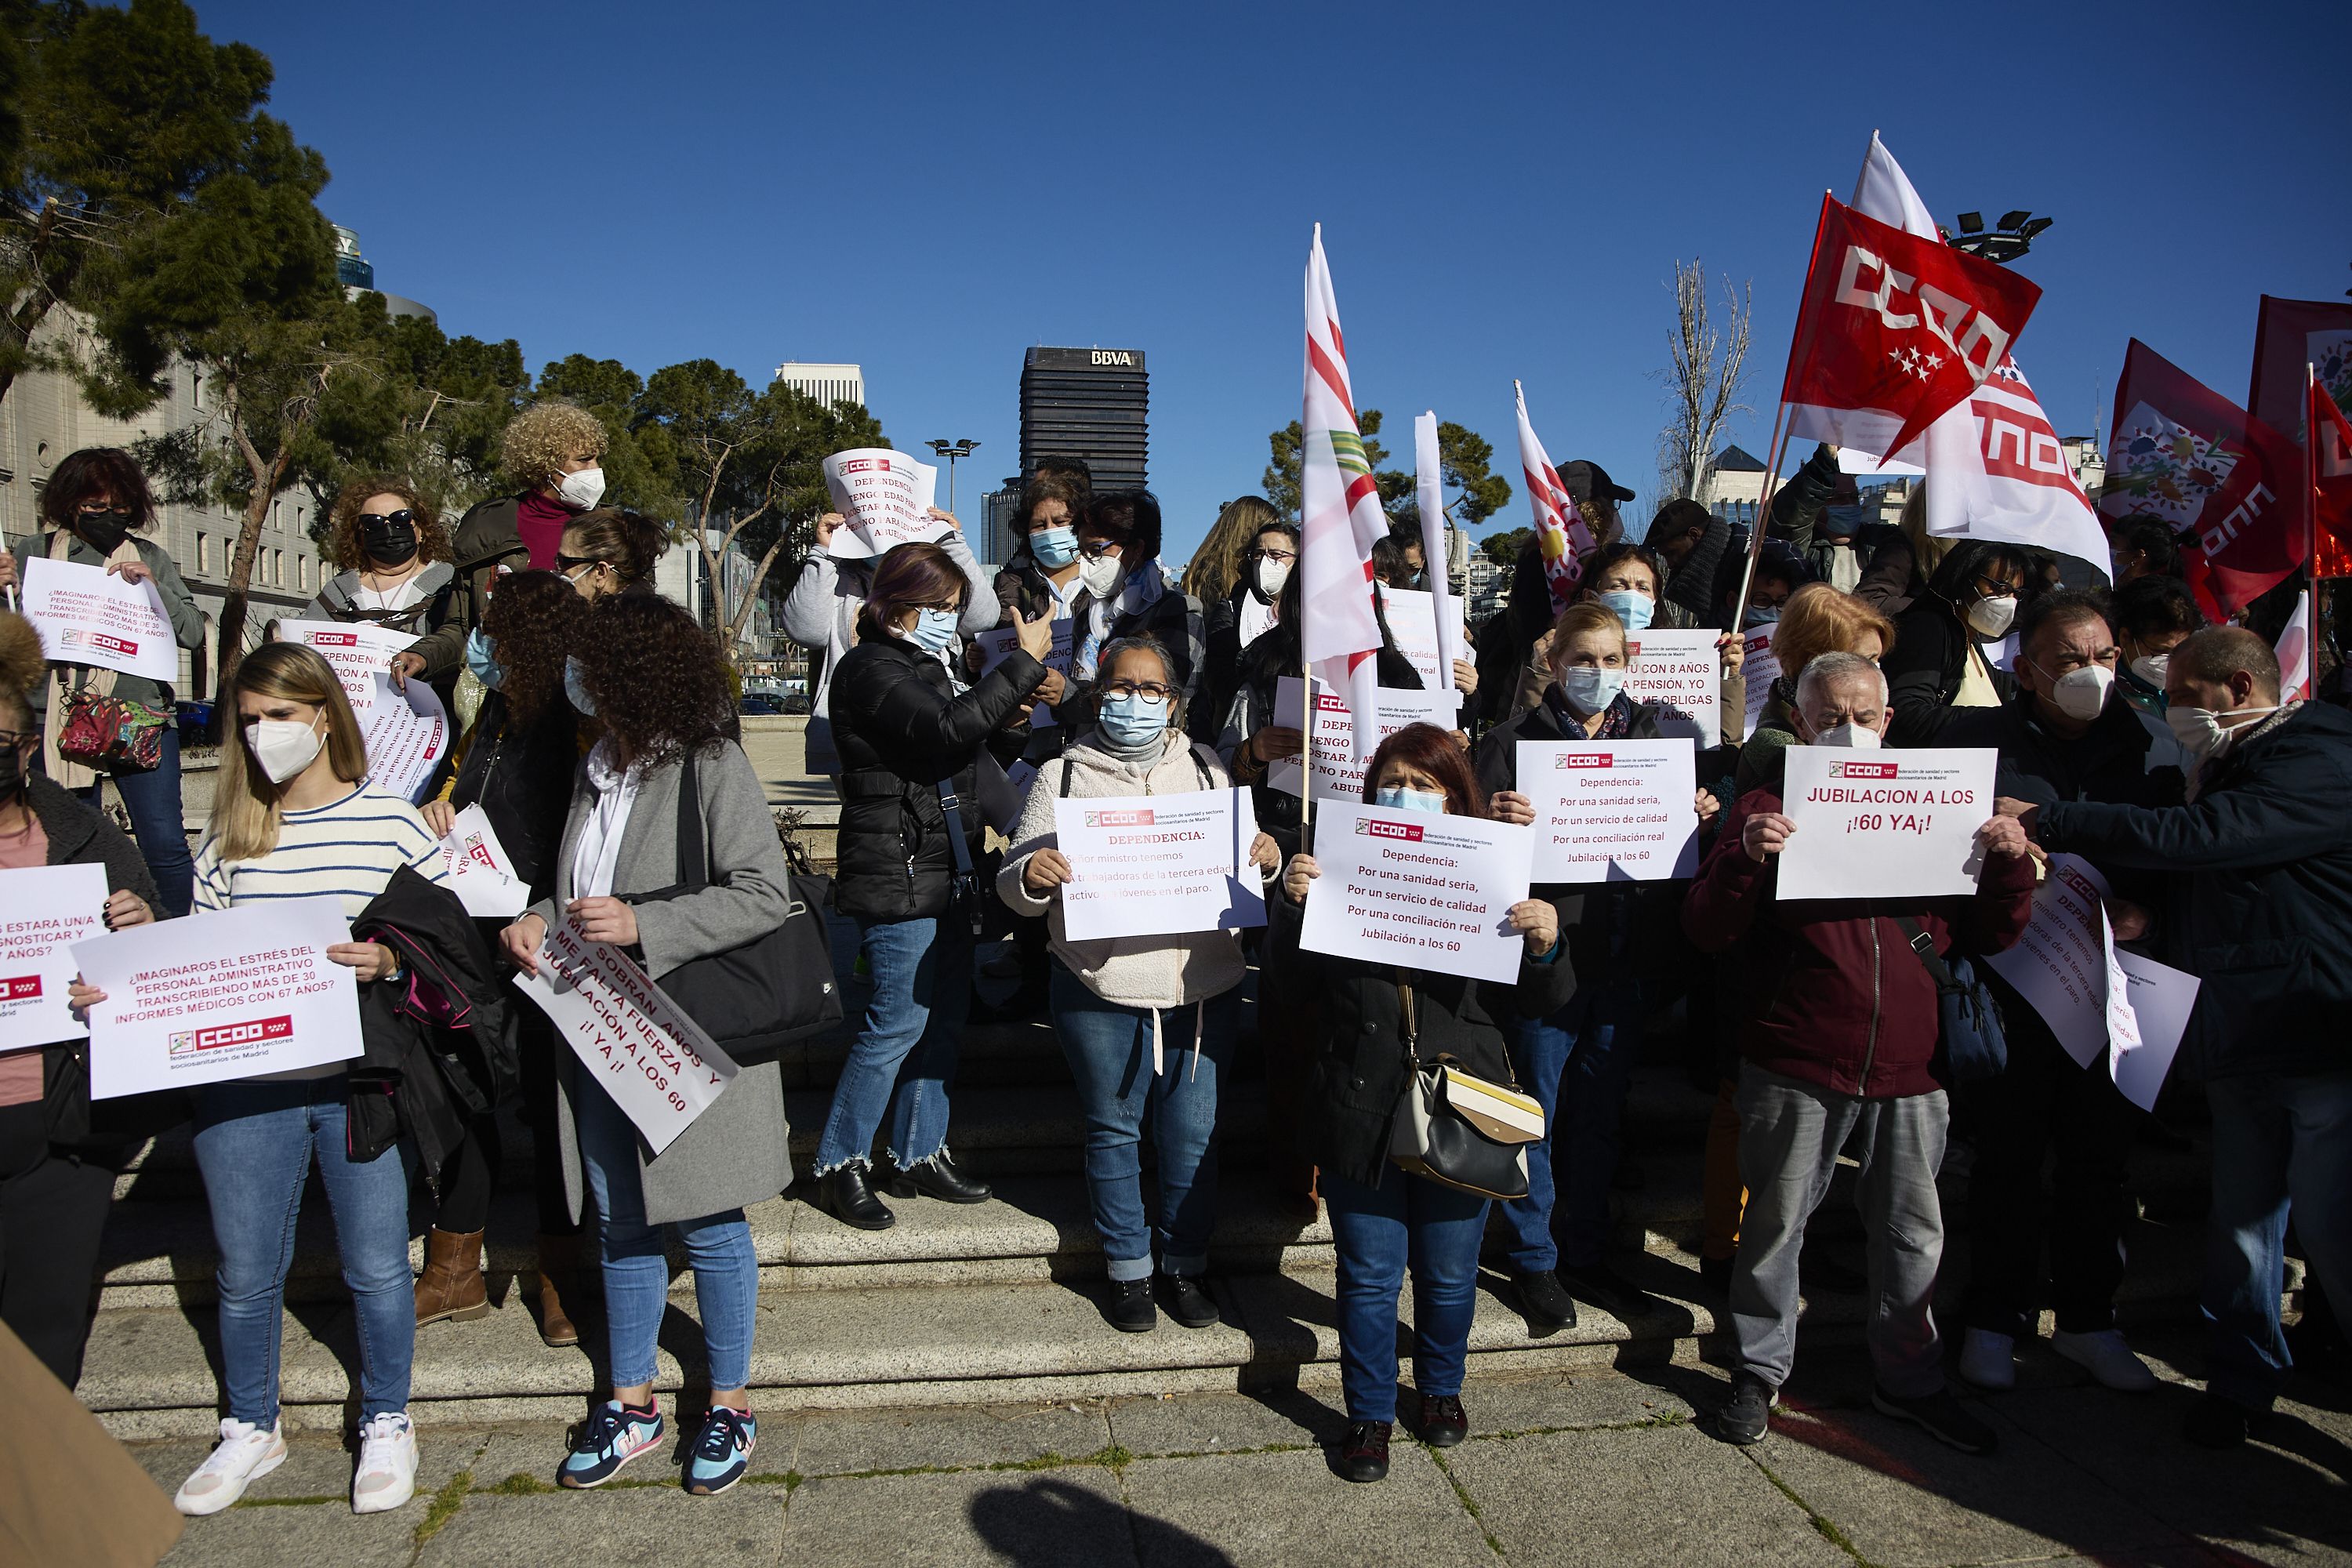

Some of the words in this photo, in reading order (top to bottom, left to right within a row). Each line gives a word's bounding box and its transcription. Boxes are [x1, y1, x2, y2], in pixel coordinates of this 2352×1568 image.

[1835, 245, 2010, 386] CCOO
[1092, 351, 1131, 365] BBVA
[850, 461, 878, 470] CCOO
[849, 491, 880, 503] TENGO
[884, 492, 904, 502] EDAD
[906, 498, 916, 510] PARA
[862, 517, 875, 526] NO
[119, 601, 151, 612] ESTRÉS
[34, 611, 75, 619] INFORMES
[117, 623, 132, 632] CON
[1624, 662, 1638, 673] TÚ
[1642, 665, 1666, 673] CON
[1679, 662, 1709, 673] AÑOS
[1633, 678, 1685, 690] PENSIÓN,
[1689, 680, 1704, 688] YO
[1642, 696, 1660, 705] ME
[1662, 695, 1712, 705] OBLIGAS
[1663, 710, 1694, 720] AÑOS
[430, 720, 442, 747] CCOO
[1310, 735, 1349, 747] TENGO
[397, 731, 427, 782] Dependencia:
[1570, 757, 1599, 765] CCOO
[1319, 766, 1335, 775] NO
[1846, 765, 1882, 776] CCOO
[1581, 779, 1642, 788] Dependencia:
[1560, 797, 1576, 806] Por
[1599, 796, 1634, 805] sanidad
[1637, 796, 1661, 804] seria,
[1807, 788, 1917, 804] JUBILACION
[1923, 790, 1934, 803] A
[1941, 790, 1973, 804] LOS
[1102, 814, 1135, 823] CCOO
[1623, 815, 1633, 823] de
[1636, 814, 1668, 822] calidad
[1109, 831, 1205, 844] DEPENDENCIA:
[1372, 824, 1406, 837] CCOO
[1593, 833, 1645, 843] conciliación
[1098, 852, 1137, 862] ministro
[1141, 851, 1183, 862] tenemos
[1383, 848, 1458, 868] Dependencia:
[1568, 852, 1613, 862] Jubilación
[1624, 851, 1636, 860] los
[1639, 851, 1650, 860] 60
[1157, 870, 1166, 879] la
[1169, 869, 1203, 878] tercera
[1207, 865, 1231, 874] edad
[1359, 866, 1377, 877] Por
[1380, 870, 1399, 880] una
[1403, 871, 1446, 887] sanidad
[1449, 880, 1479, 893] seria,
[1174, 886, 1183, 895] el
[1186, 885, 1212, 895] paro.
[1348, 884, 1366, 895] Por
[1369, 887, 1381, 898] un
[1385, 890, 1427, 905] servicio
[1430, 897, 1443, 908] de
[1446, 899, 1486, 913] calidad
[7, 920, 60, 932] ESTARA
[65, 916, 94, 926] UN/A
[1348, 905, 1366, 916] Por
[1370, 909, 1389, 919] una
[1392, 912, 1456, 930] conciliación
[1460, 924, 1480, 933] real
[1362, 927, 1415, 944] Jubilación
[1428, 938, 1443, 949] los
[1447, 942, 1460, 952] 60
[2033, 900, 2066, 929] ministro
[2066, 928, 2094, 965] tenemos
[7, 946, 52, 959] AÑOS?
[130, 961, 216, 985] ¿IMAGINAROS
[221, 958, 236, 967] EL
[241, 949, 287, 965] ESTRÉS
[292, 946, 315, 956] DEL
[136, 975, 205, 995] PERSONAL
[210, 958, 313, 982] ADMINISTRATIVO
[2070, 961, 2089, 990] tercera
[136, 984, 249, 1008] TRANSCRIBIENDO
[253, 977, 278, 989] MÁS
[284, 974, 298, 985] DE
[303, 971, 315, 980] 30
[2050, 964, 2060, 975] en
[2060, 976, 2070, 985] el
[2065, 985, 2080, 1006] paro.
[116, 1006, 183, 1024] INFORMES
[188, 996, 244, 1013] MÉDICOS
[249, 991, 274, 1003] CON
[279, 989, 291, 998] 67
[296, 980, 335, 995] AÑOS?
[556, 930, 580, 958] ME
[580, 958, 625, 1010] FALTA
[627, 1009, 681, 1076] FUERZA
[596, 946, 657, 1016] SOBRAN
[661, 1022, 703, 1067] AÑOS
[709, 1073, 721, 1085] Y
[200, 1024, 263, 1047] CCOO
[543, 951, 627, 1041] JUBILACIÓN
[625, 1043, 637, 1057] A
[637, 1056, 668, 1091] LOS
[668, 1091, 686, 1112] 60
[224, 1044, 254, 1054] sanidad
[262, 1038, 293, 1047] sectores
[594, 1032, 612, 1059] YA
